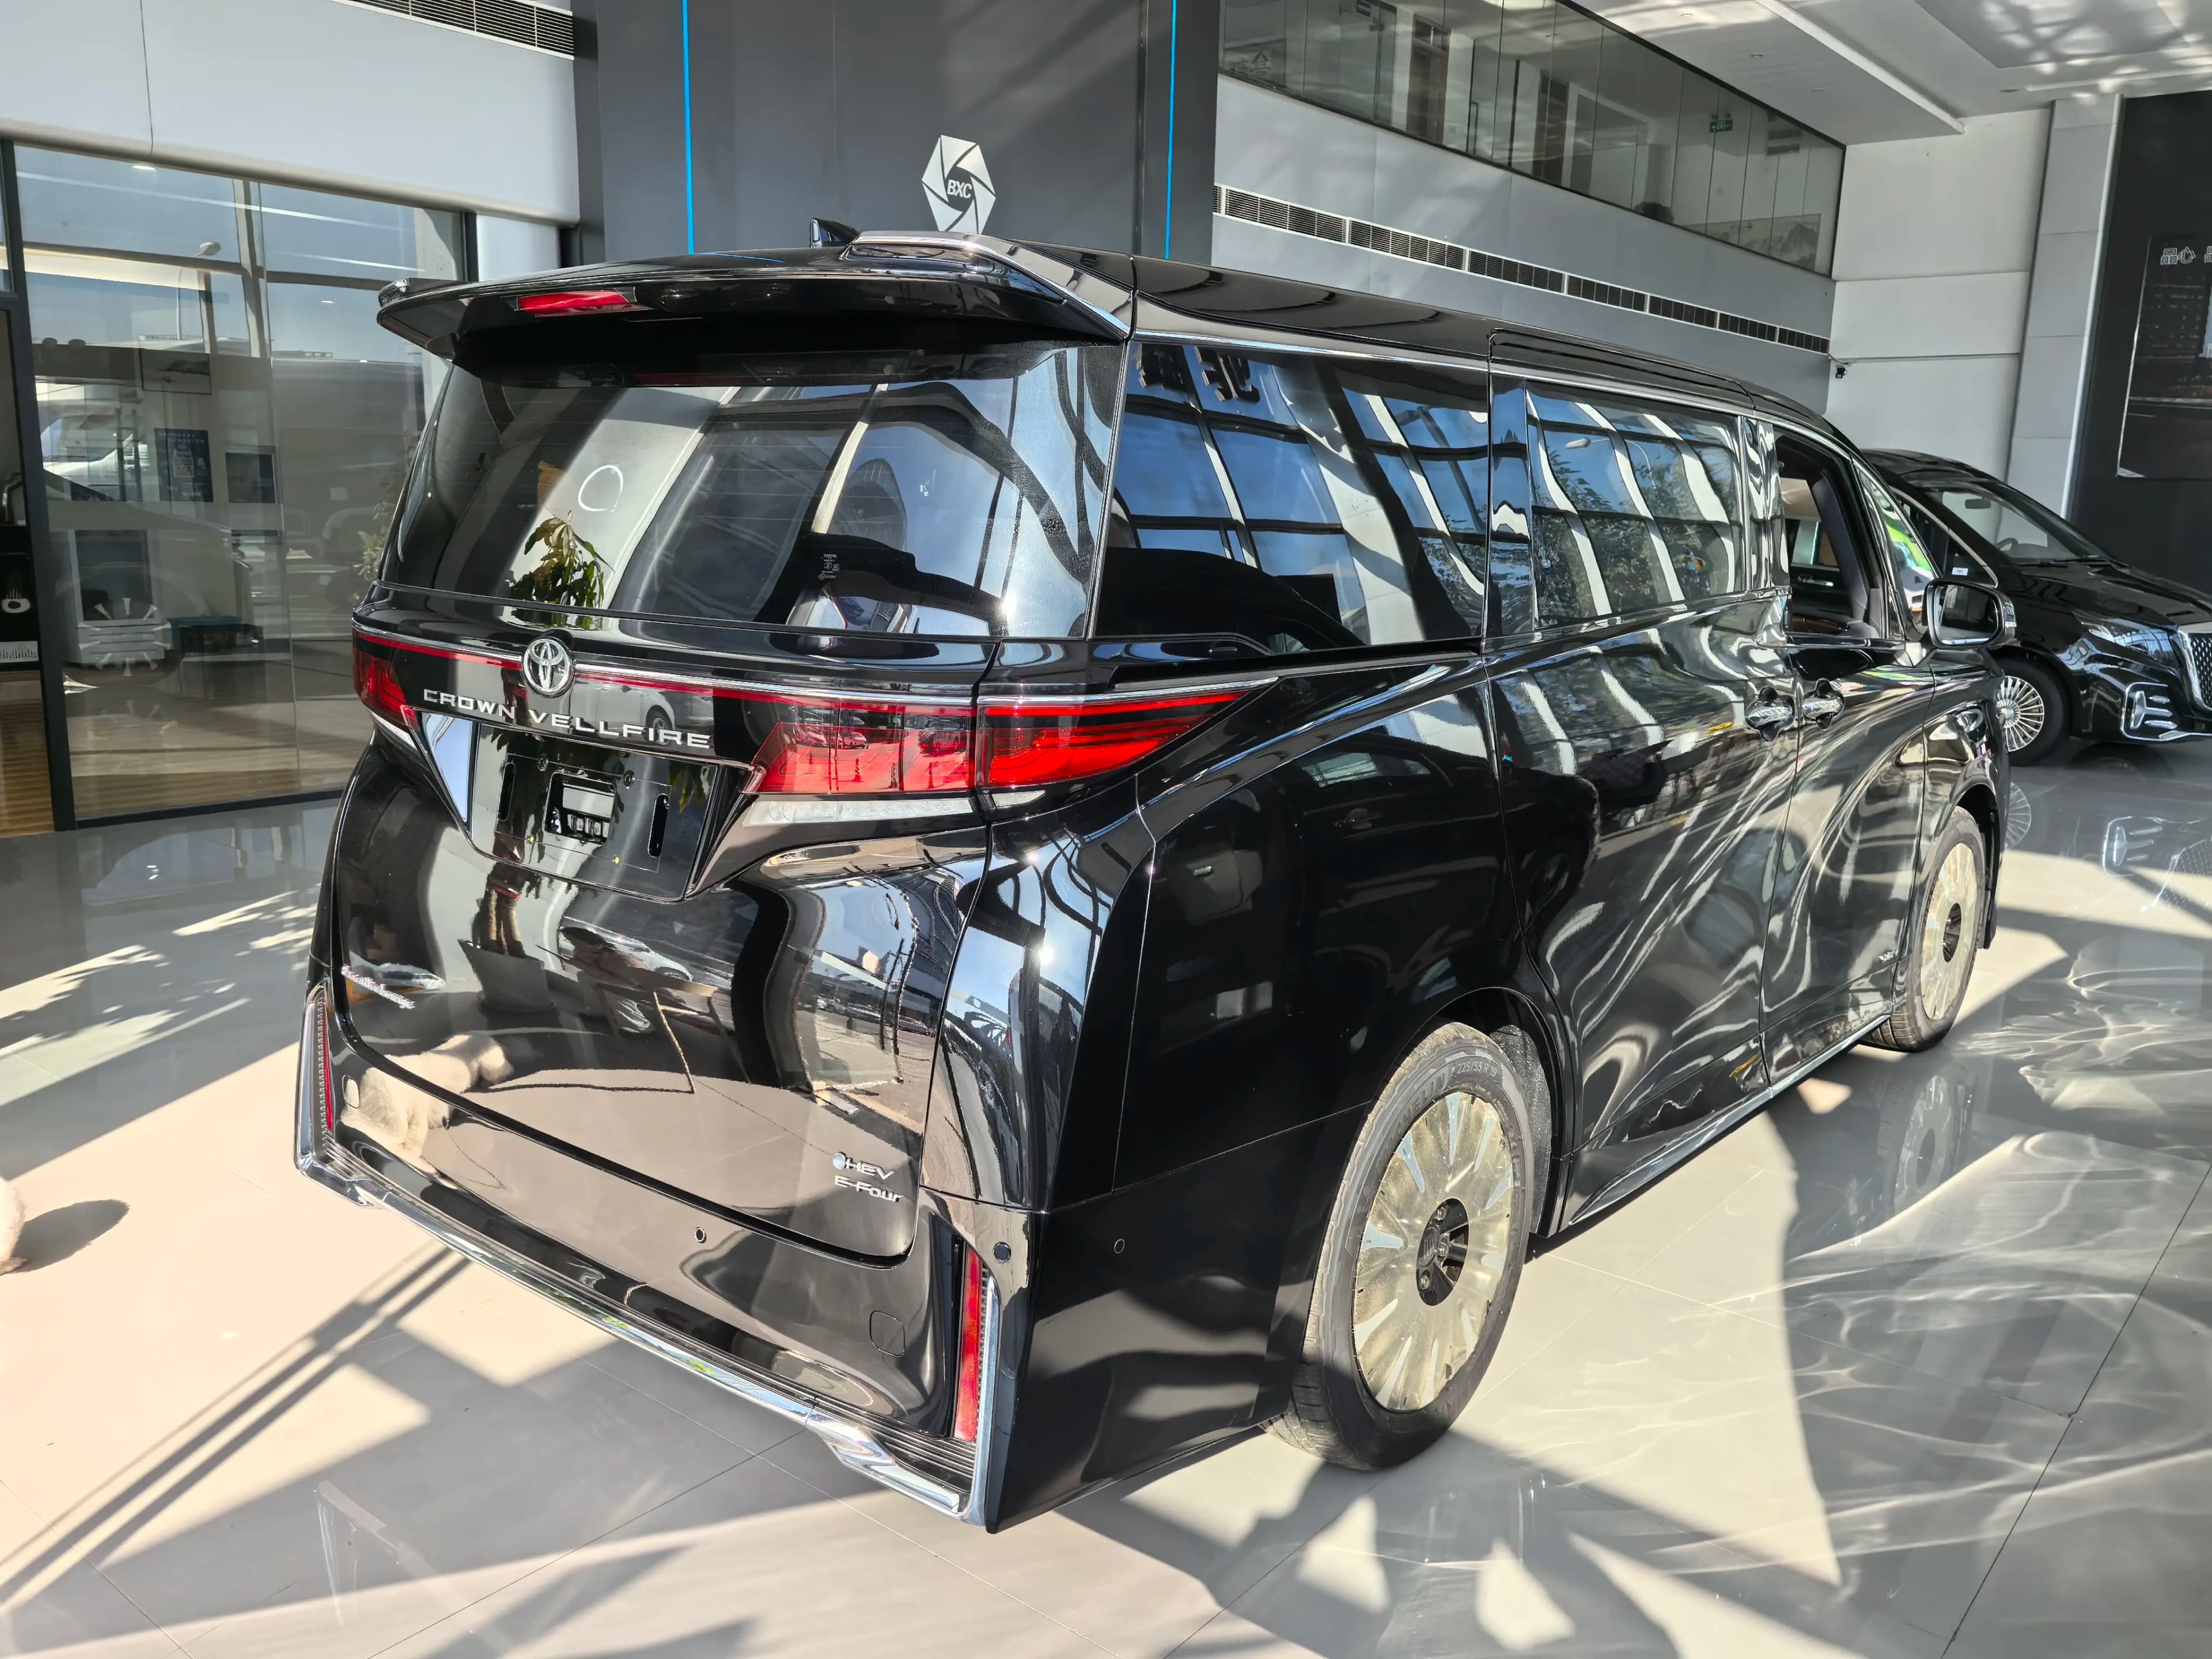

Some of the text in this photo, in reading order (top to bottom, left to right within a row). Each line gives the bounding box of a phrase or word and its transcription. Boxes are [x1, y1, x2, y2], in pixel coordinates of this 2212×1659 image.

[946, 179, 973, 199] BXC
[423, 688, 711, 749] CROWN VELLFIRE
[1456, 1060, 1498, 1077] 225/55 R 19
[846, 1158, 895, 1180] HEV
[834, 1175, 905, 1203] E-Four
